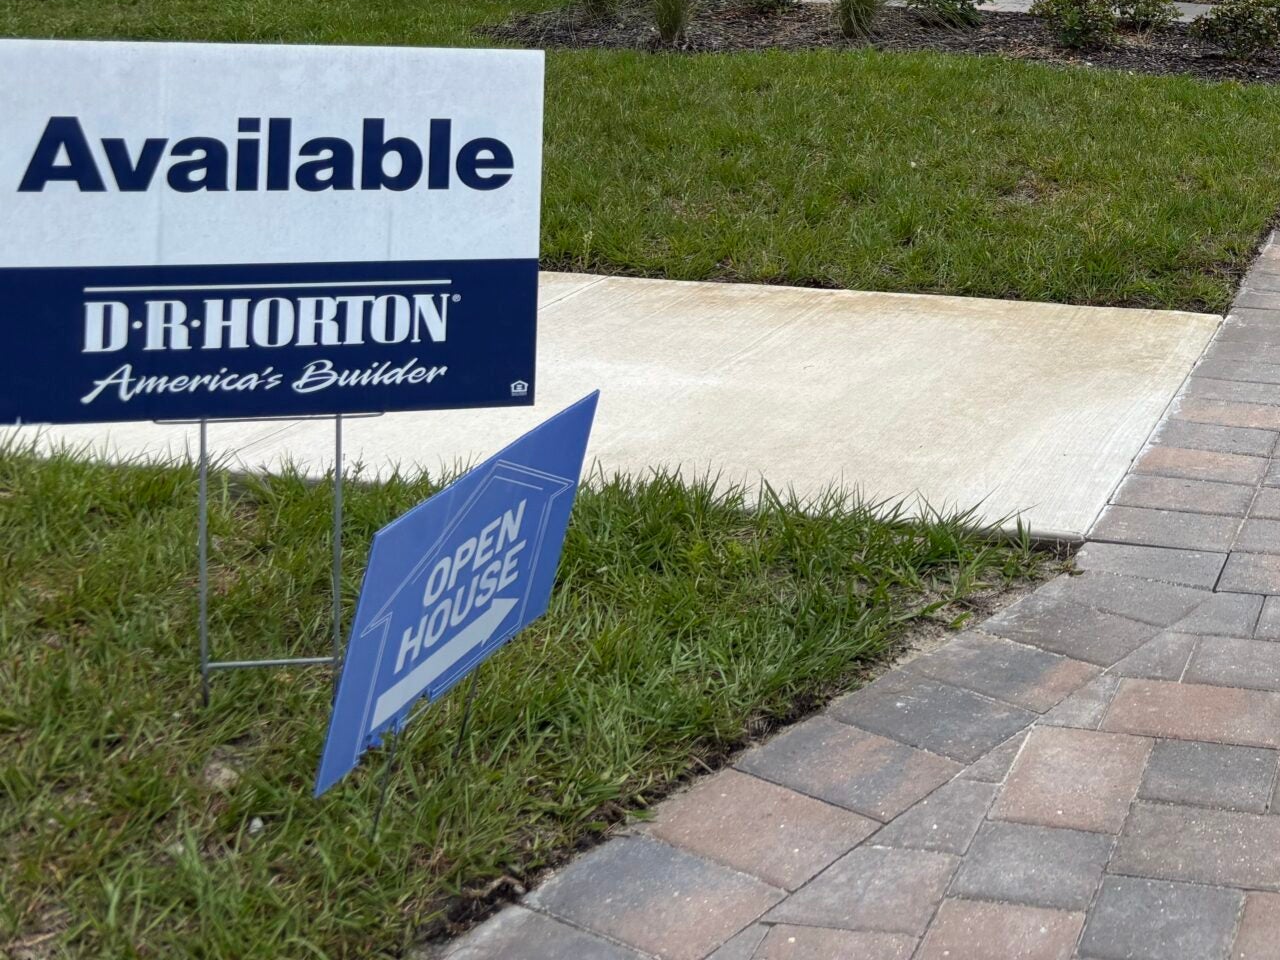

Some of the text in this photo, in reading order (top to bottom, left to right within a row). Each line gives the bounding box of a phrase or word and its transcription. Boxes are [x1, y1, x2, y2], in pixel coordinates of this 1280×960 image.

[17, 116, 515, 193] Available
[80, 358, 448, 404] America's Builder
[422, 498, 528, 608] OPEN
[394, 538, 528, 676] HOUSE
